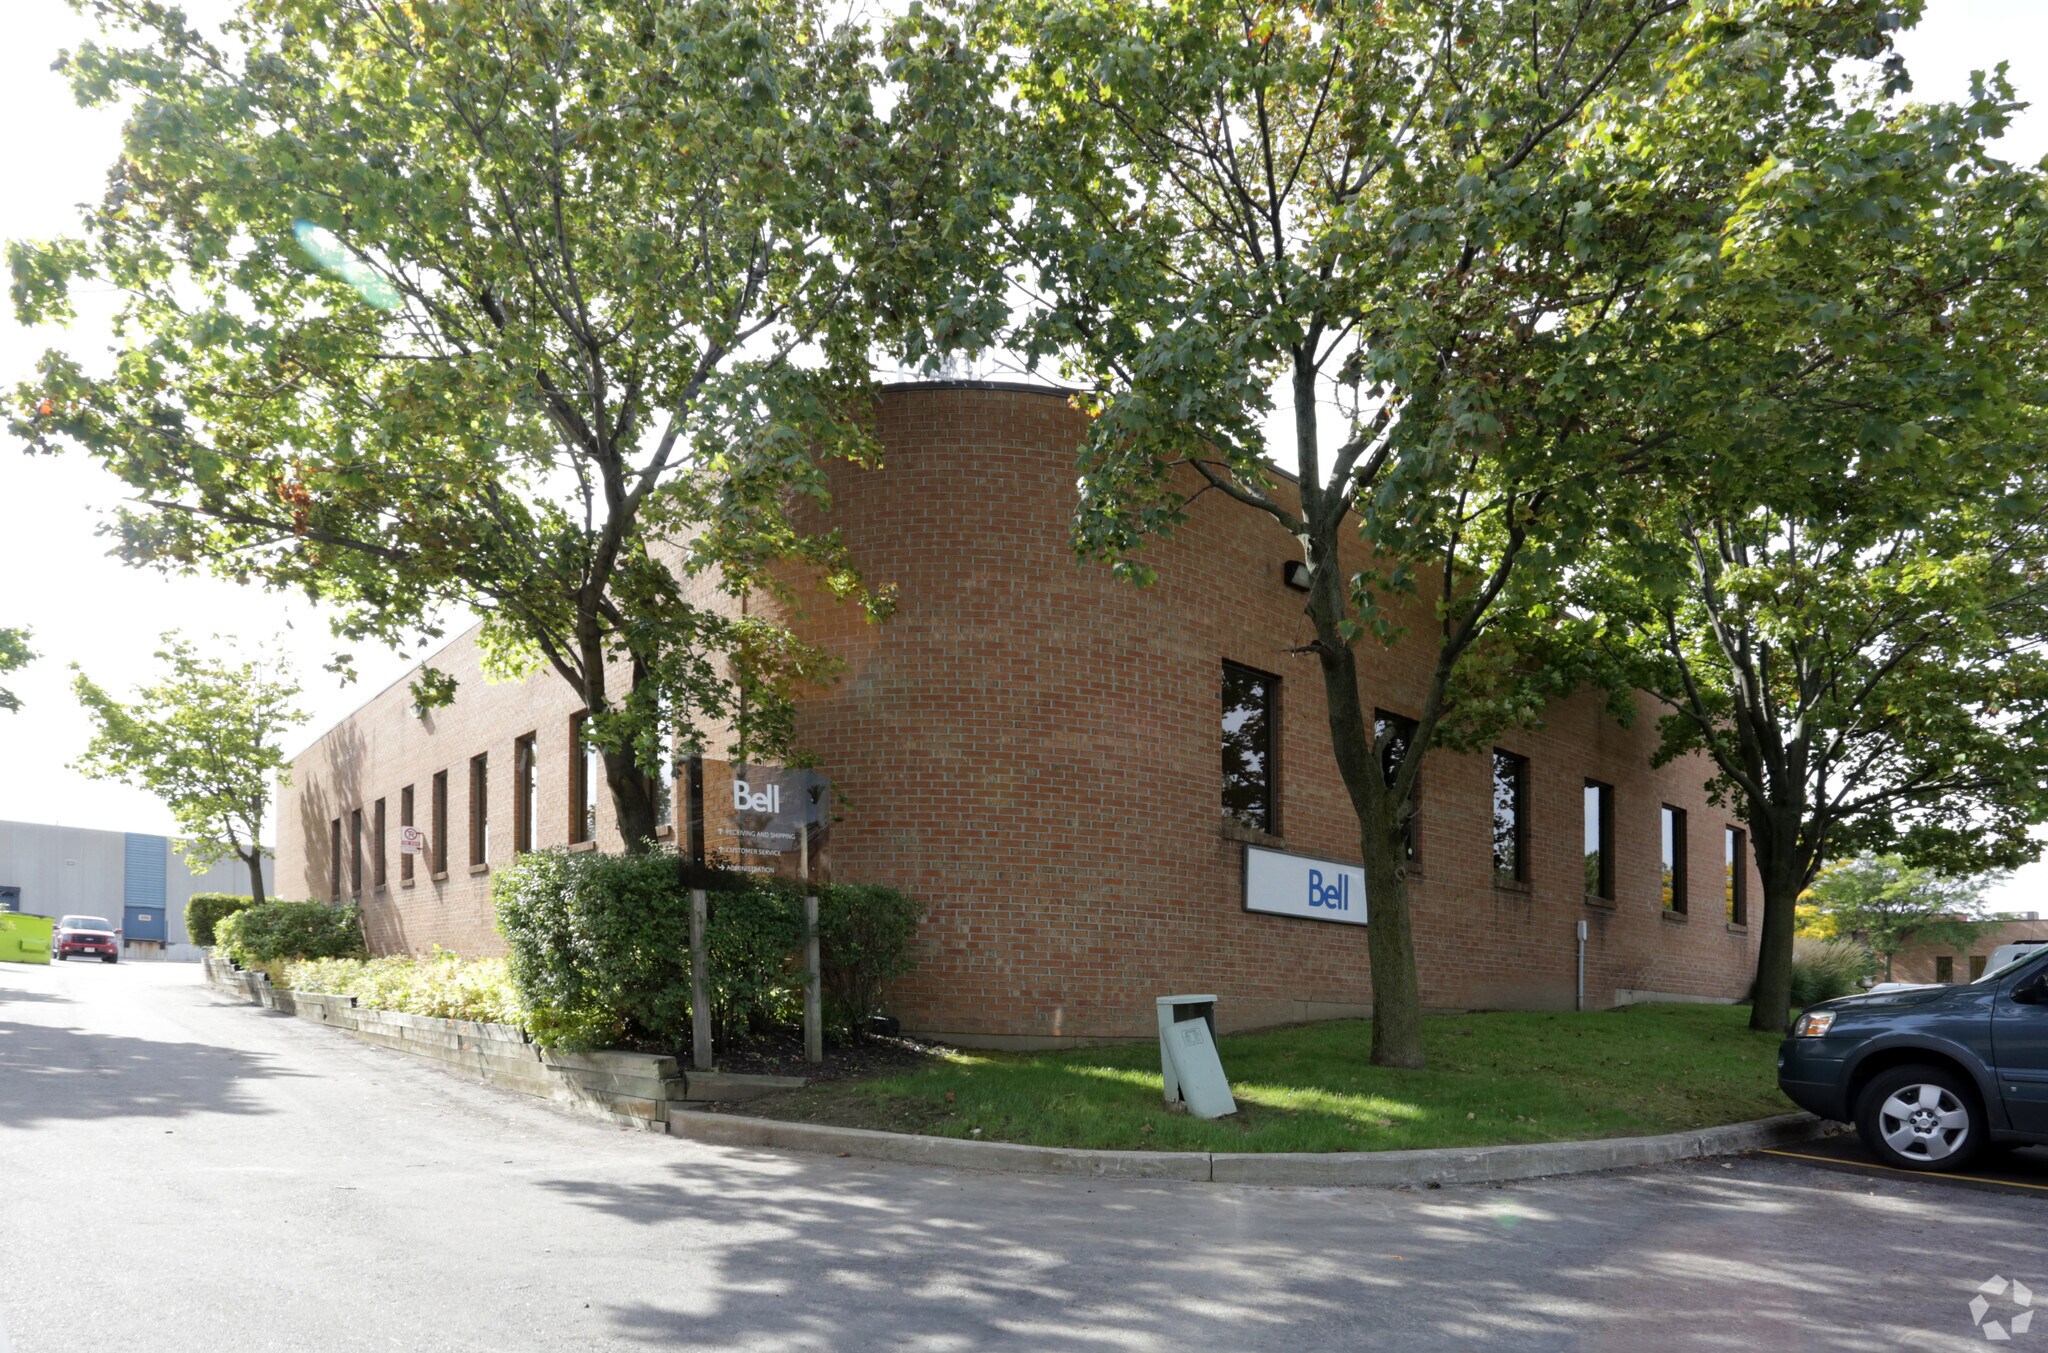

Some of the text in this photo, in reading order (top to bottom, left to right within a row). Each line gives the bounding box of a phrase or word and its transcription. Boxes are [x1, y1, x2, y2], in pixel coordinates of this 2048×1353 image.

[733, 780, 780, 813] Bell
[725, 829, 756, 837] RECEIVING
[770, 832, 796, 840] SHIPPING
[725, 847, 781, 857] CUSTOMER SERVICE
[726, 865, 775, 874] ADMINISTRATION
[1308, 869, 1349, 911] Bell
